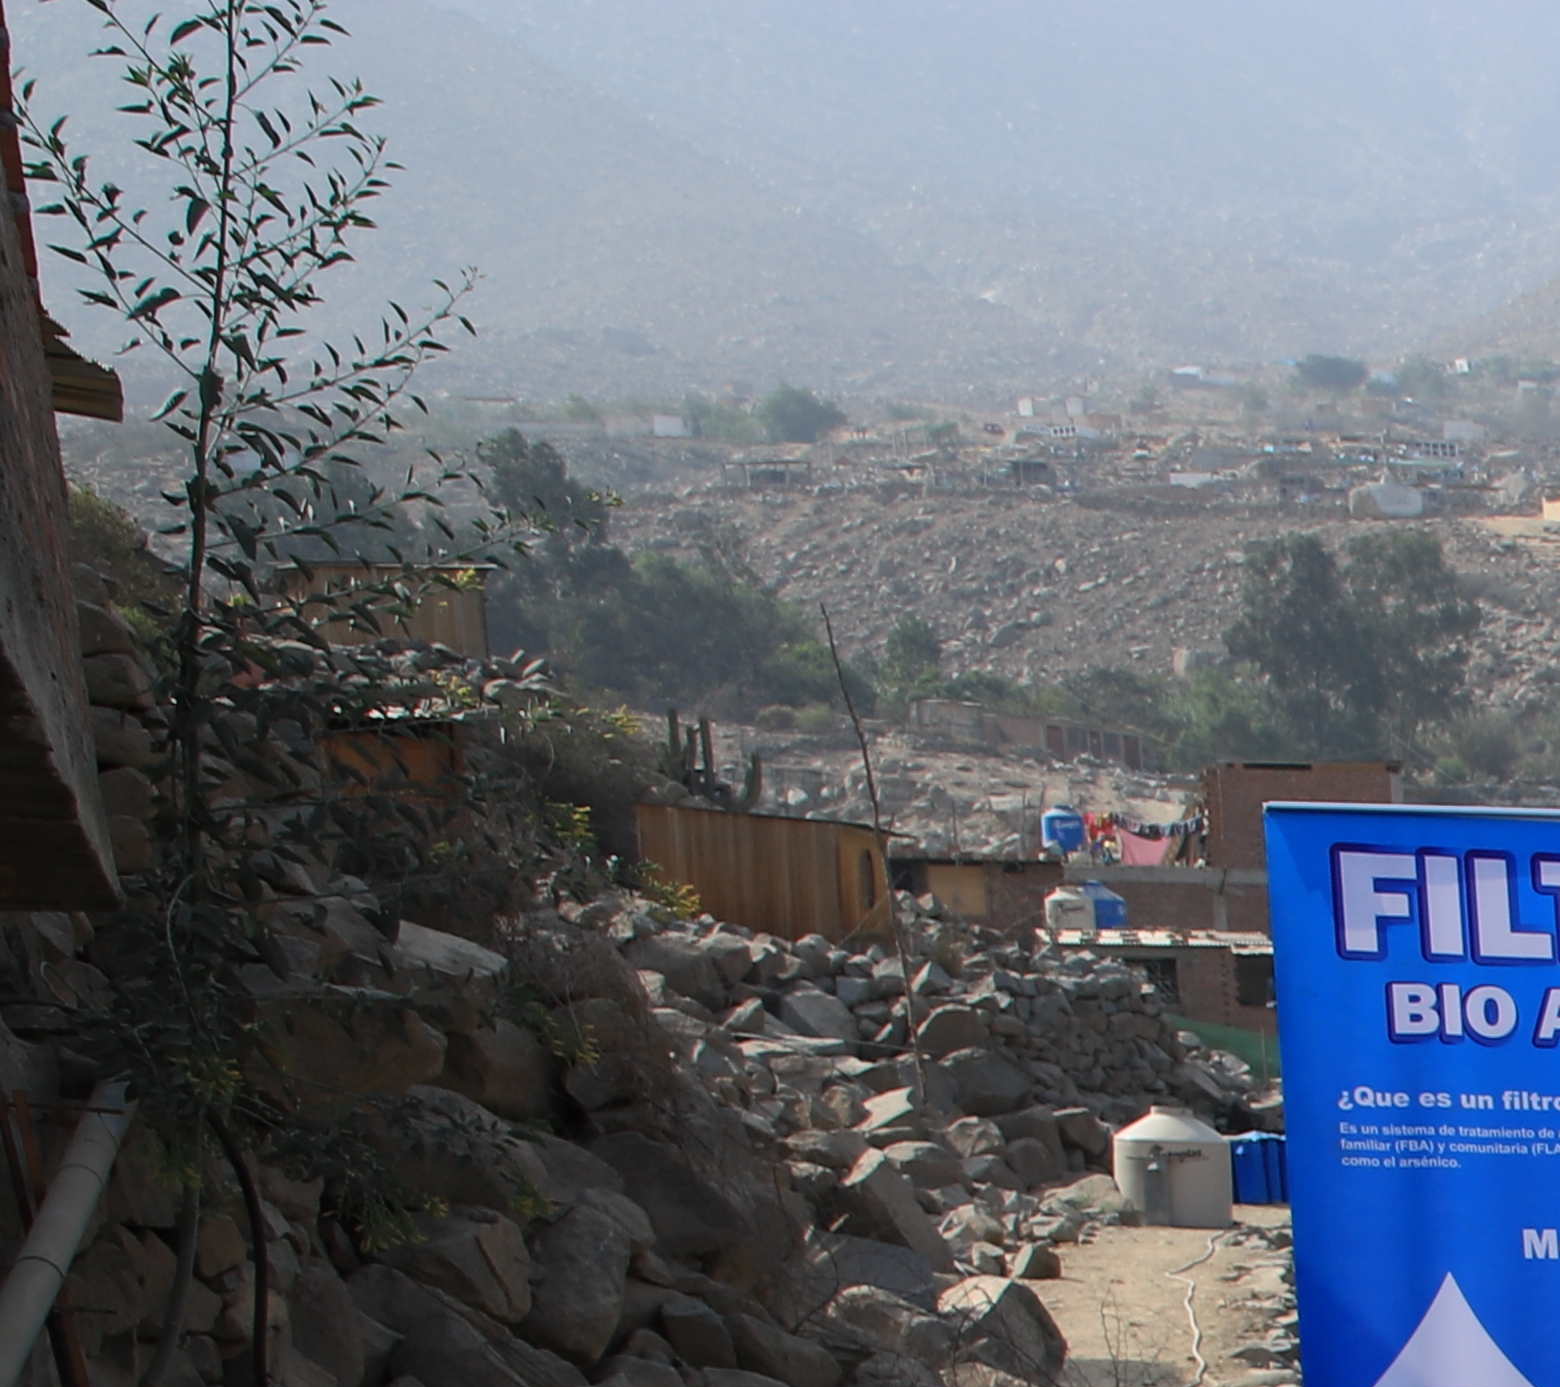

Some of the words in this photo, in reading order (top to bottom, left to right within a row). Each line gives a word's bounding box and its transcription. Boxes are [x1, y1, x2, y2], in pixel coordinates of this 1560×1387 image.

[1390, 981, 1518, 1041] BIO
[1337, 1085, 1410, 1110] ¿Que
[1418, 1091, 1452, 1107] es
[1460, 1093, 1494, 1109] un
[1339, 1121, 1357, 1134] Es
[1360, 1125, 1378, 1135] un
[1381, 1123, 1435, 1135] sistema
[1438, 1123, 1456, 1136] de
[1457, 1125, 1535, 1138] tratamiento
[1537, 1127, 1555, 1139] de
[1340, 1137, 1391, 1151] familiar
[1394, 1139, 1434, 1153] (FBA)
[1436, 1141, 1446, 1154] y
[1448, 1142, 1528, 1154] comunitaria
[1341, 1156, 1380, 1167] como
[1382, 1155, 1396, 1167] el
[1398, 1155, 1460, 1168] arsénico.
